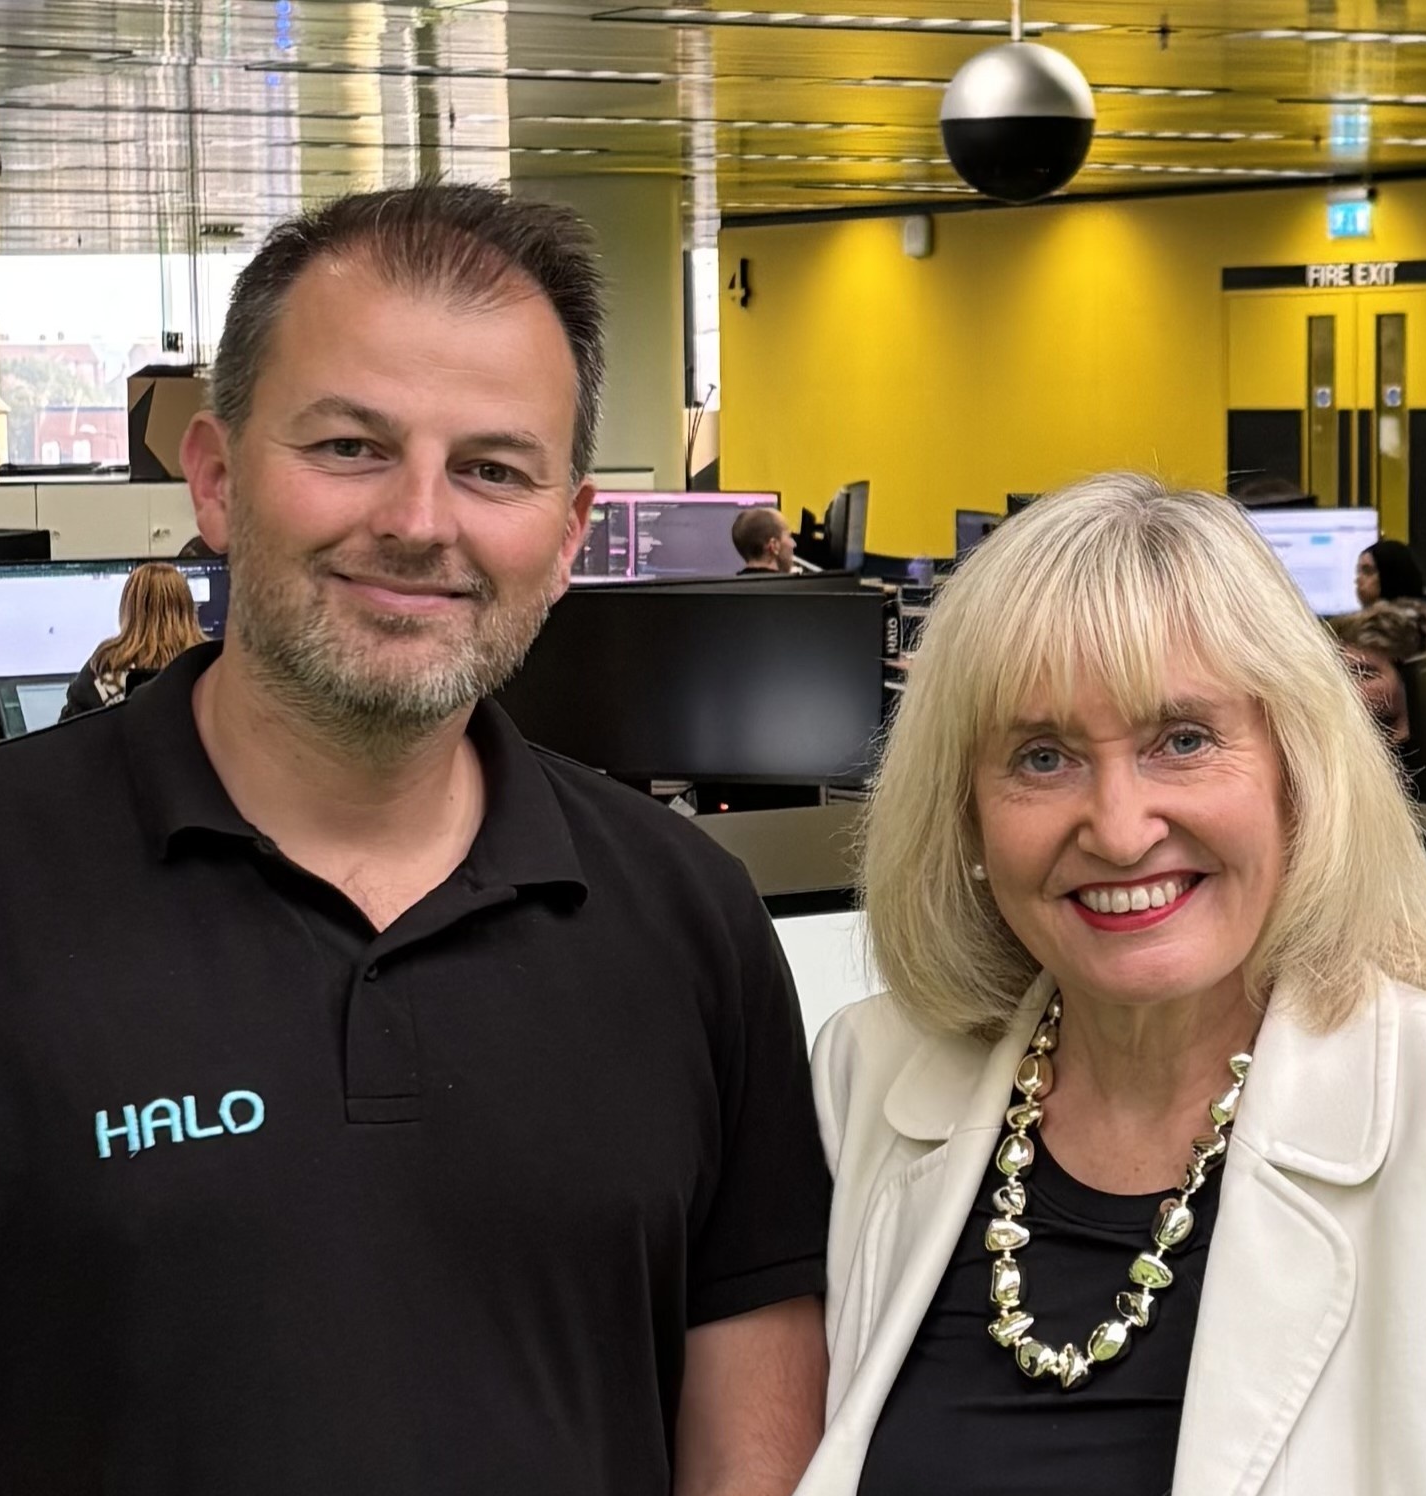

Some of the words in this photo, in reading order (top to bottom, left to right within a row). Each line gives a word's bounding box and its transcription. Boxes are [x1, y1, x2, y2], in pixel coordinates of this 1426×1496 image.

[1305, 263, 1350, 287] FIRE
[1353, 262, 1398, 286] EXIT
[95, 1089, 265, 1159] HALO
